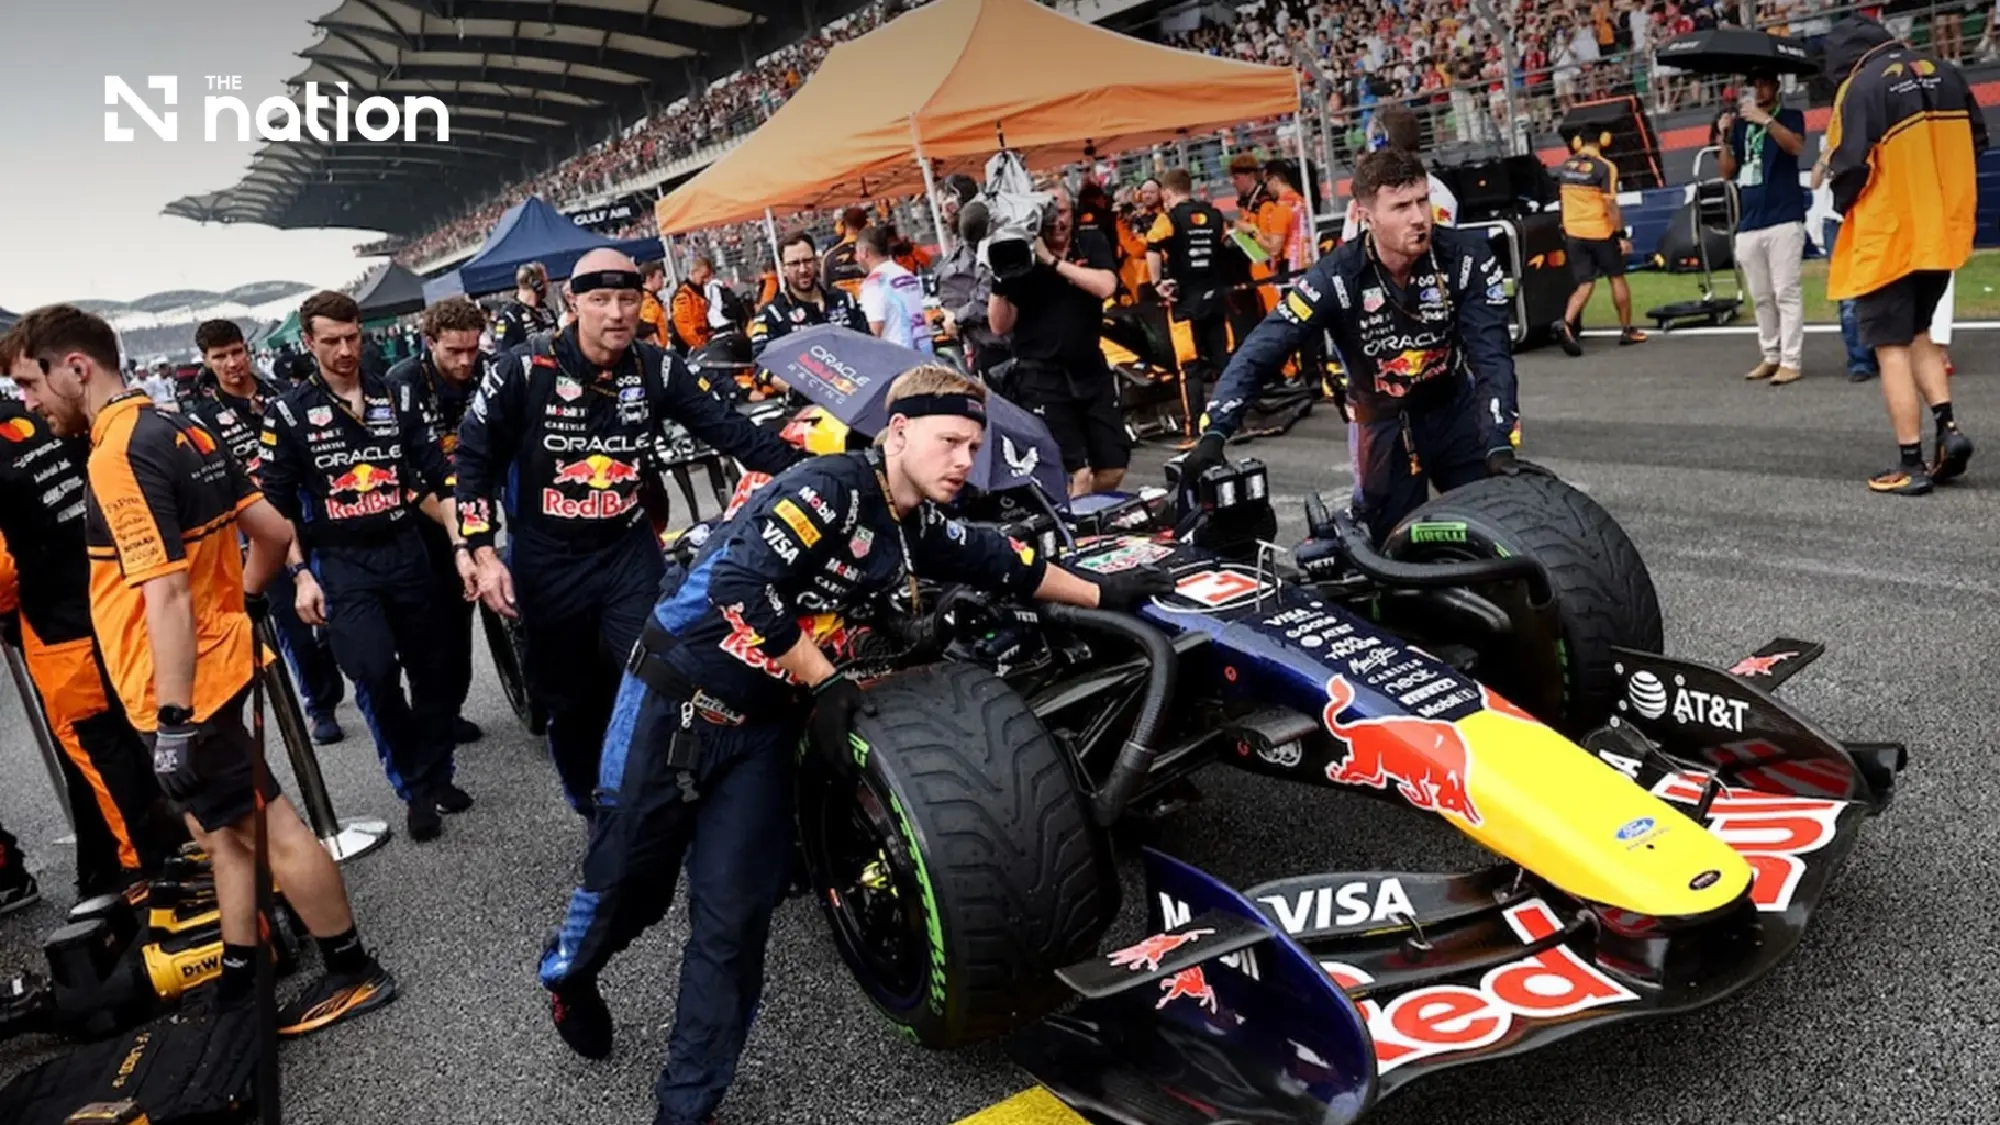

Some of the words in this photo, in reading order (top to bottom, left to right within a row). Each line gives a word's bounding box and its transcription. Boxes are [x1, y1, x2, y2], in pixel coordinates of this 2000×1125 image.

[574, 209, 607, 225] GULF
[609, 207, 632, 220] AIR
[810, 344, 871, 388] ORACLE
[787, 362, 846, 406] RACING
[542, 431, 650, 453] ORACLE
[315, 444, 402, 469] ORACLE
[325, 492, 368, 520] Red
[542, 487, 602, 518] Red
[798, 485, 837, 524] Mobil
[762, 519, 800, 567] VISA
[1411, 521, 1467, 543] PIRELLI
[825, 557, 859, 581] Mobil
[1304, 556, 1335, 571] YETI
[1263, 608, 1311, 627] VISA
[1418, 693, 1463, 718] Mobil
[1673, 689, 1749, 733] AT&T
[1256, 877, 1416, 935] VISA
